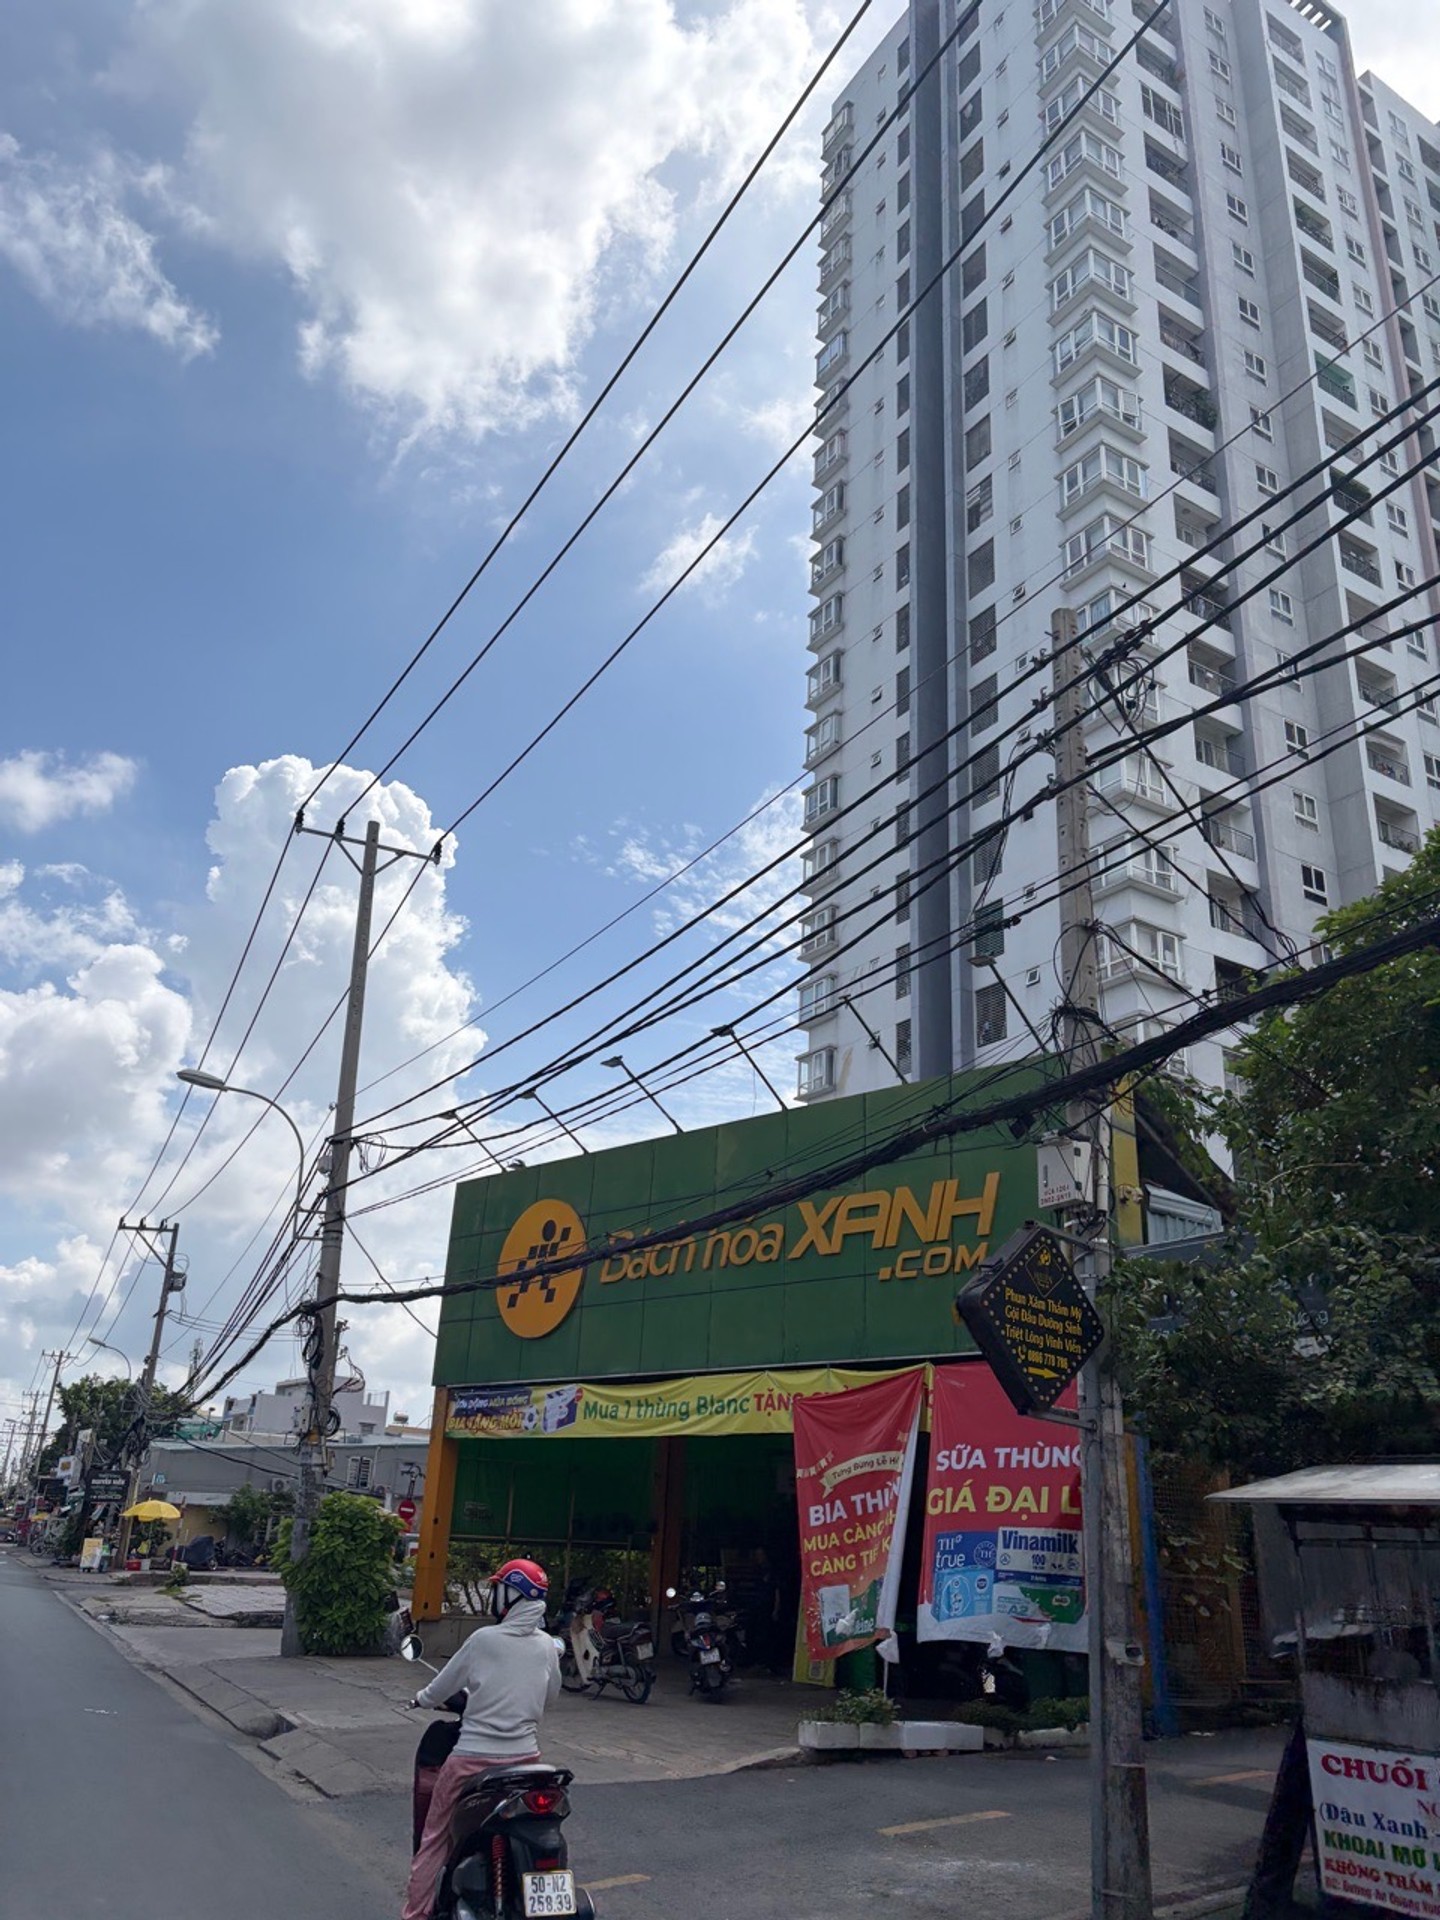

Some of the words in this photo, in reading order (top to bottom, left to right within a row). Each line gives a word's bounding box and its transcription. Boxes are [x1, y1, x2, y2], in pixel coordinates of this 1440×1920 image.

[787, 1171, 1000, 1260] XANH
[878, 1242, 989, 1281] .COM
[583, 1400, 618, 1420] Mua
[636, 1395, 690, 1421] thùng
[696, 1394, 750, 1416] Blanc
[936, 1443, 987, 1472] SỮA
[809, 1499, 848, 1527] BIA
[926, 1479, 976, 1516] GIÁ
[986, 1485, 1049, 1521] ĐẠI
[1060, 1485, 1083, 1515] L
[803, 1532, 840, 1553] MUA
[1001, 1530, 1080, 1554] Vinamilk
[811, 1553, 857, 1577] CÀNG
[935, 1551, 966, 1568] true
[1321, 1754, 1428, 1790] CHUỐI
[1319, 1801, 1366, 1828] (Đậu
[1373, 1812, 1429, 1840] Xanh
[1324, 1829, 1386, 1860] KHOAI
[1324, 1856, 1380, 1883] KHÔNG
